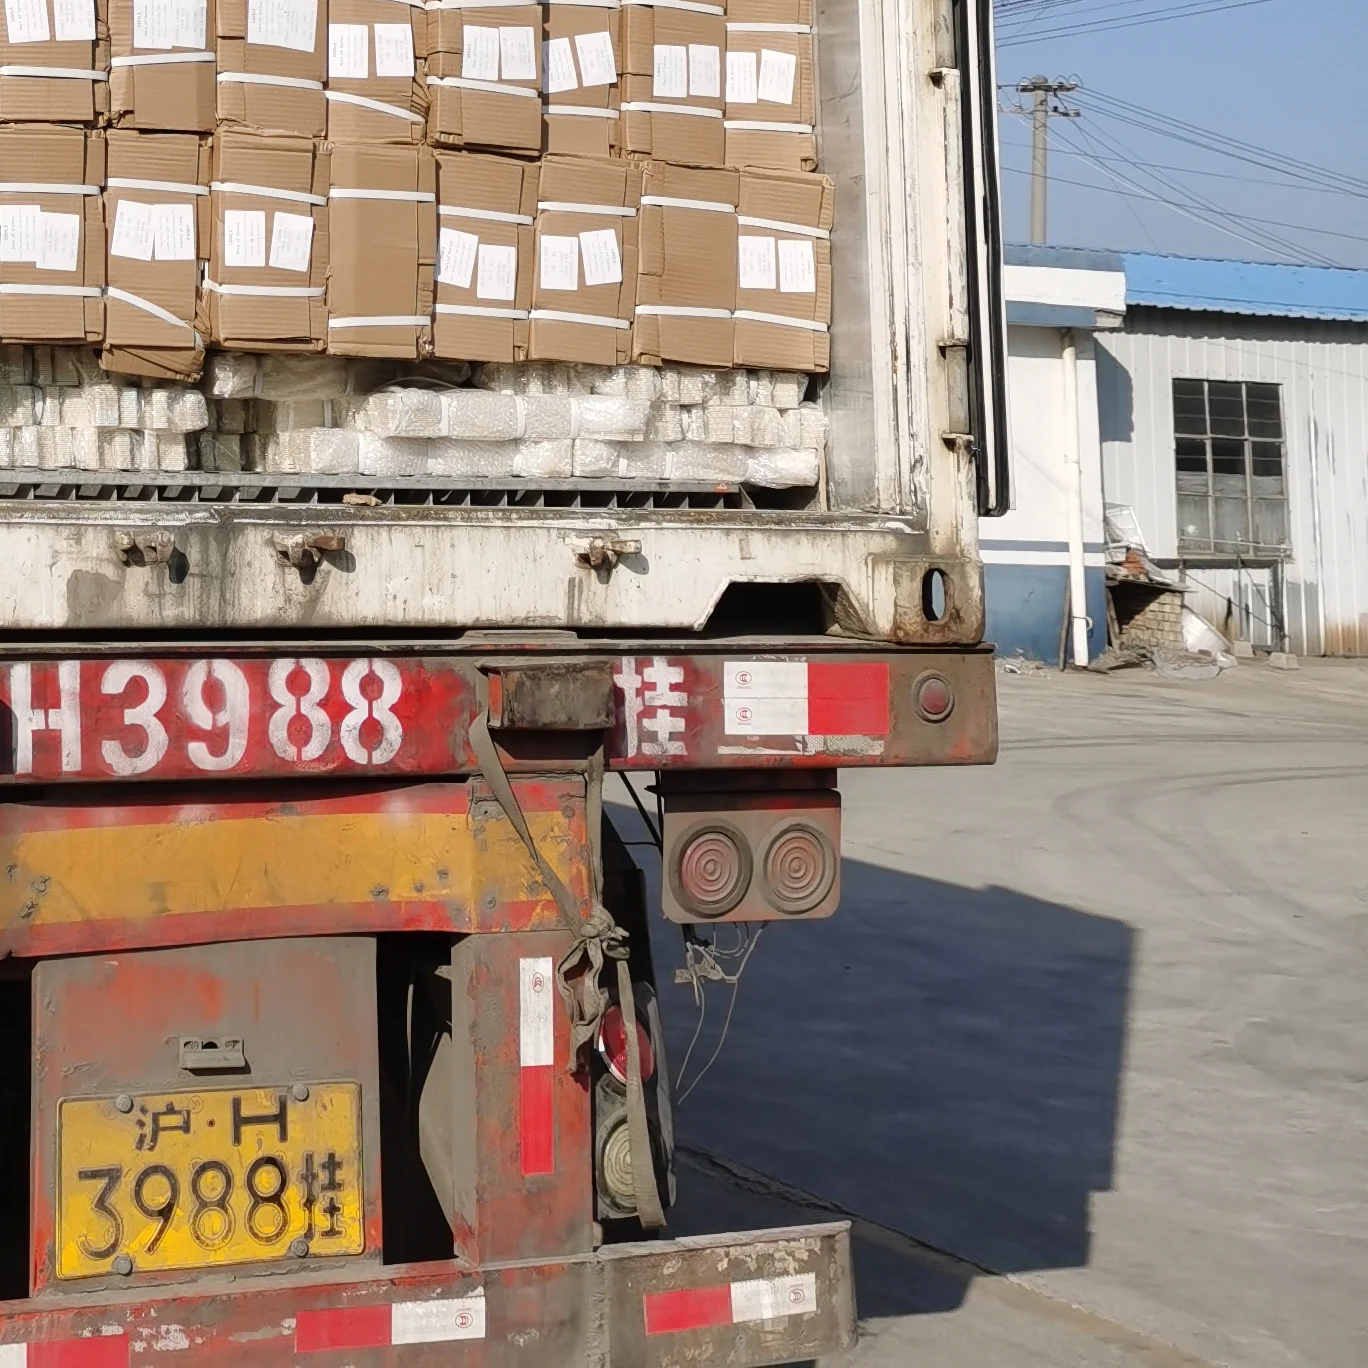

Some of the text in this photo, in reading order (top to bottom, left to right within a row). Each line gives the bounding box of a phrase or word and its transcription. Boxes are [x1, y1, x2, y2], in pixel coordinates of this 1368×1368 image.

[12, 658, 404, 776] H3988
[613, 656, 688, 757] 挂
[76, 1152, 344, 1260] 3988挂
